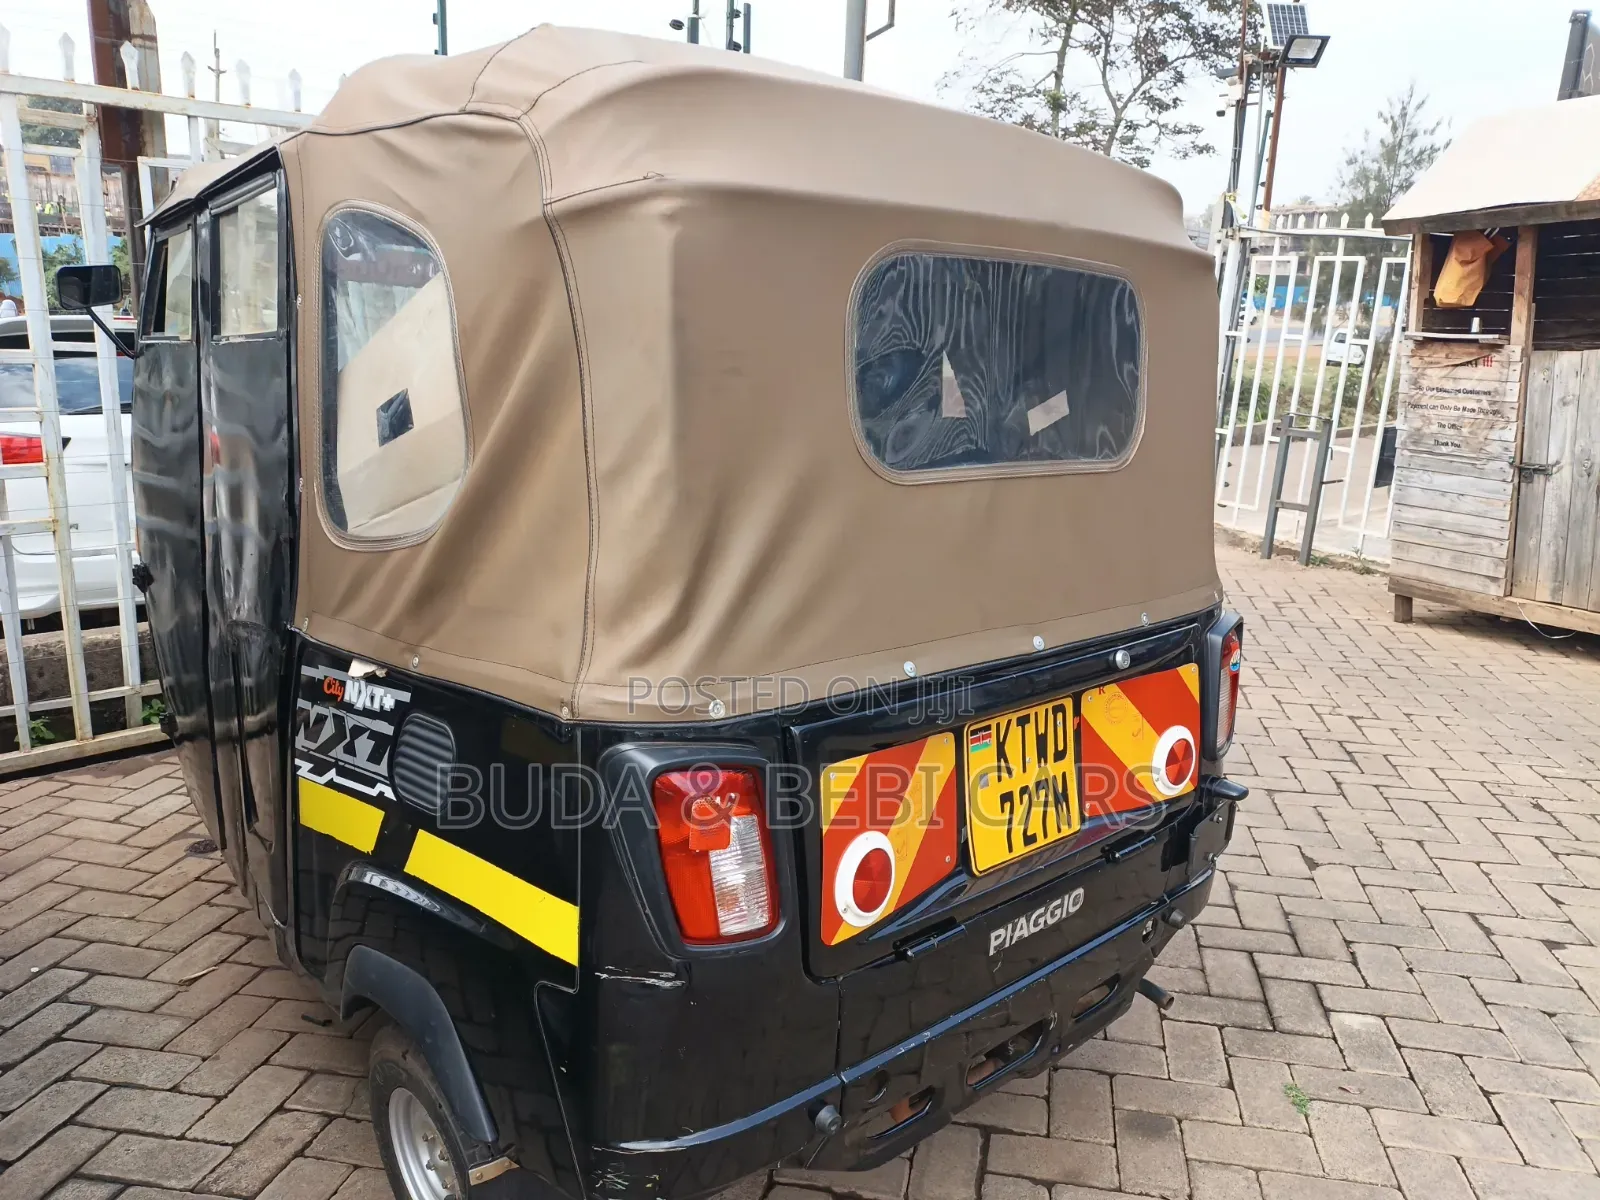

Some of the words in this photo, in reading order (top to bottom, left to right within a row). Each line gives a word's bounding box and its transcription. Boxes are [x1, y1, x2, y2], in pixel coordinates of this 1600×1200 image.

[1407, 402, 1428, 411] Payment
[1440, 404, 1453, 413] Only
[1461, 405, 1477, 414] Made
[1437, 421, 1447, 429] The
[1433, 439, 1449, 447] Thank
[323, 676, 345, 702] City
[995, 703, 1068, 783] KTWD
[999, 771, 1072, 854] 727M
[989, 887, 1085, 957] PIAGGIO
